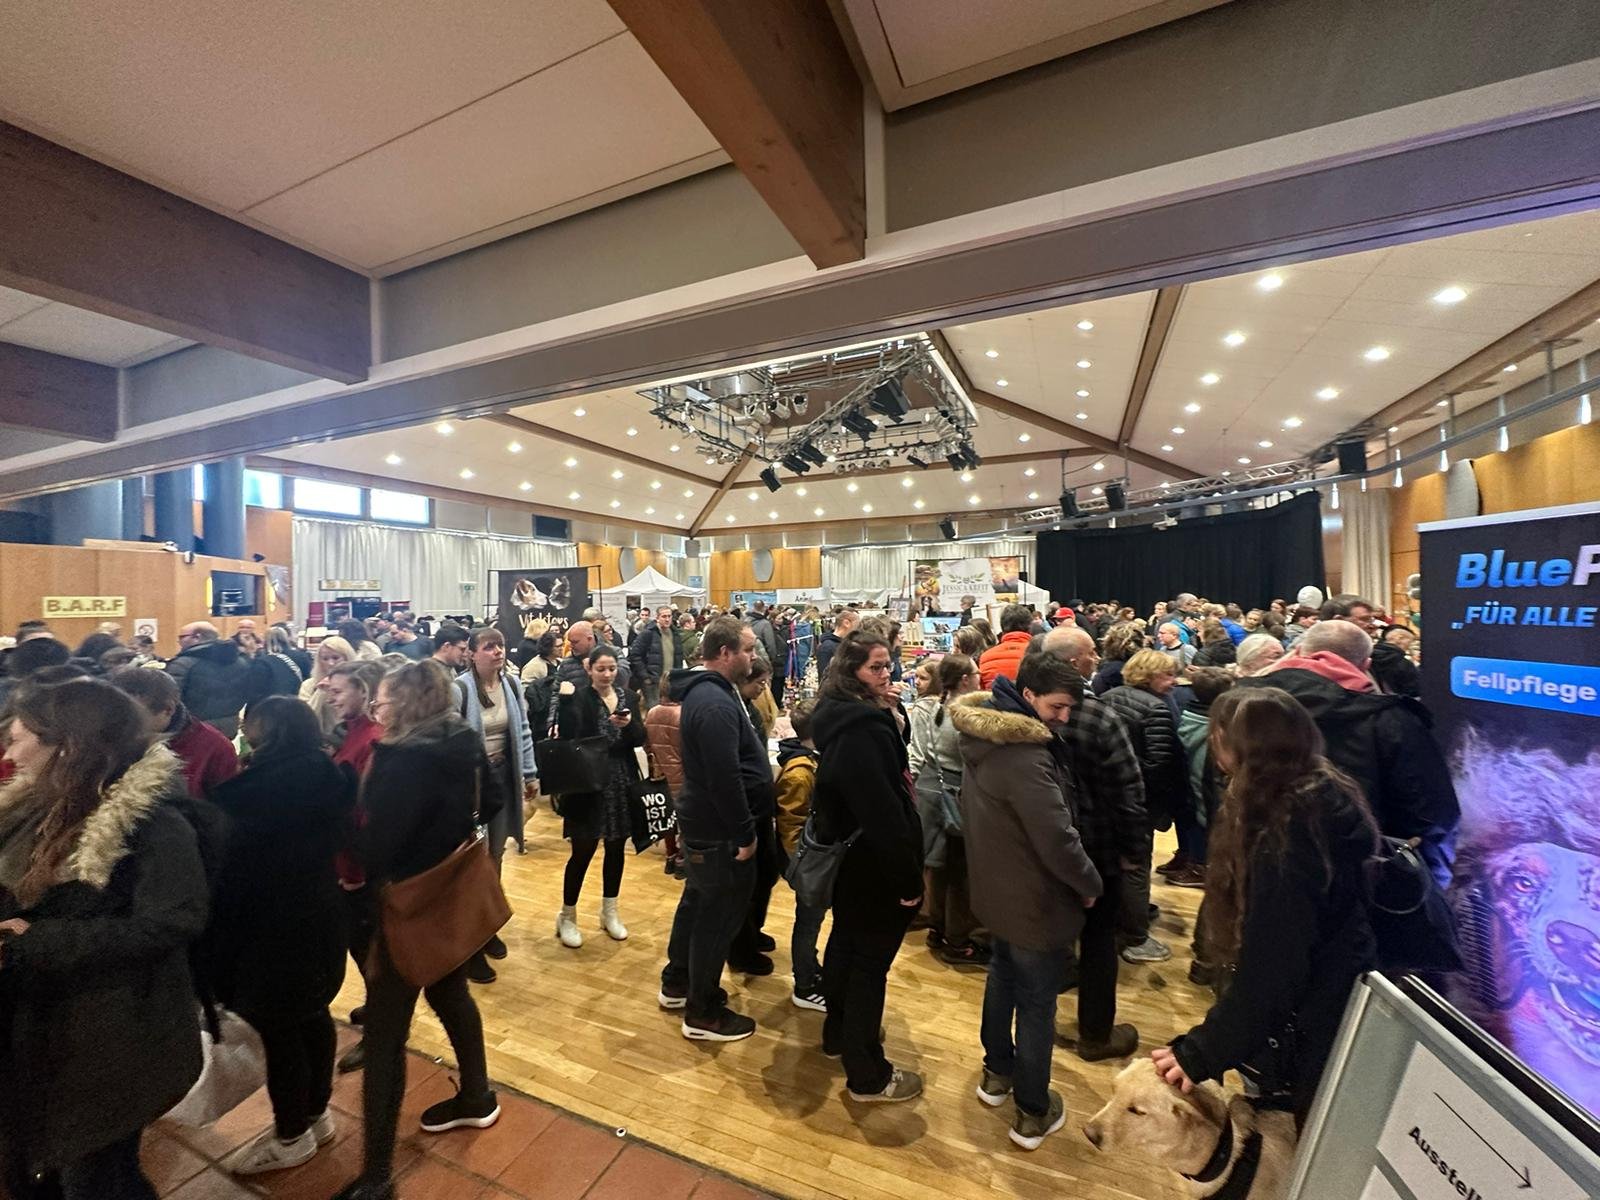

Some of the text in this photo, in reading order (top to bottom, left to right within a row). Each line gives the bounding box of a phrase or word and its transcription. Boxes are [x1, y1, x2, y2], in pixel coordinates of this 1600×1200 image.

[46, 599, 124, 612] B.A.R.F
[1522, 606, 1599, 627] ALLE
[1463, 670, 1598, 703] Fellpflege
[641, 793, 666, 807] WO
[646, 806, 667, 820] IST
